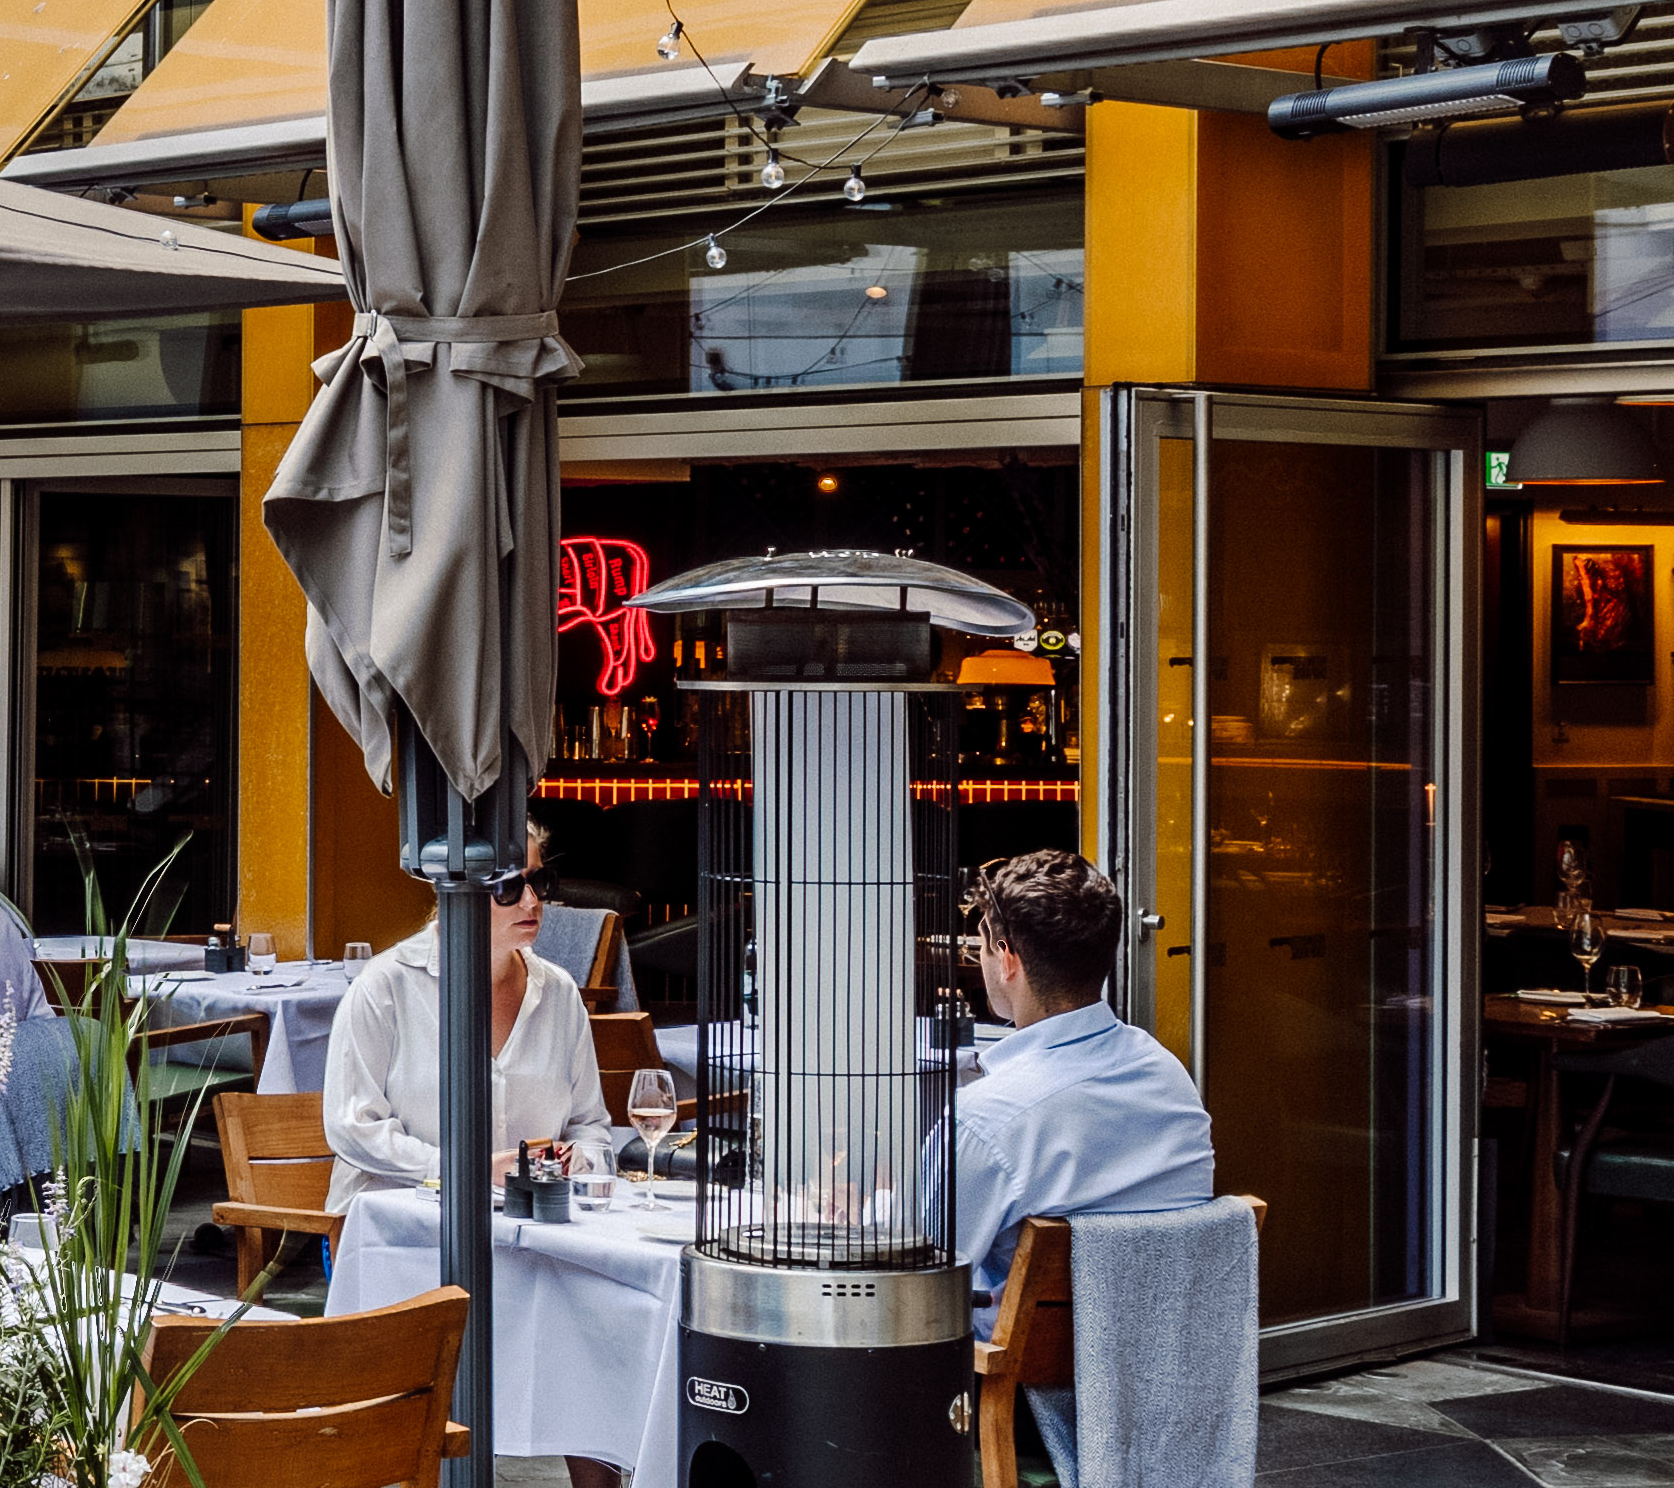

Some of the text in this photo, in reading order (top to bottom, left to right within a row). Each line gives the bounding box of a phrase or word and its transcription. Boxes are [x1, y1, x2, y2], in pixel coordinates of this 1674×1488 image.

[608, 558, 627, 596] Rump
[694, 1380, 727, 1400] HEAT
[694, 1395, 727, 1408] outdoors
